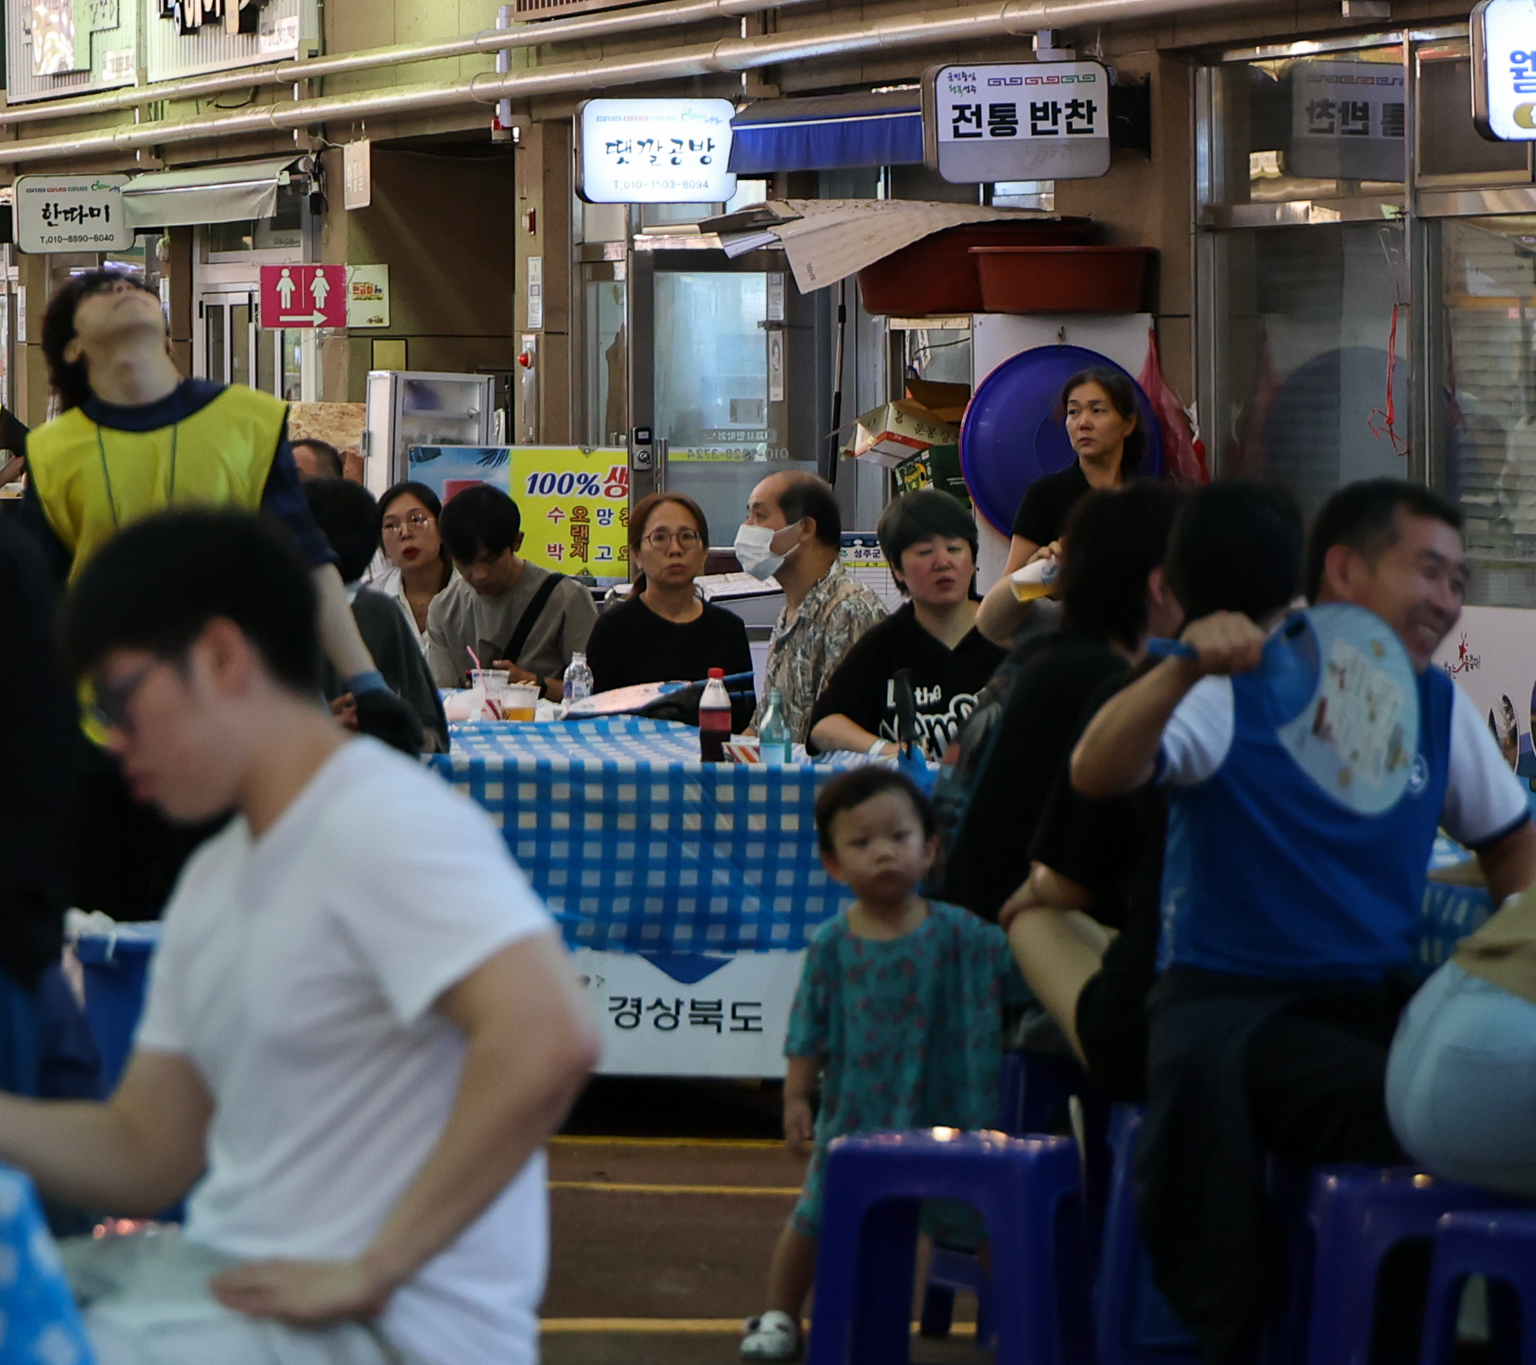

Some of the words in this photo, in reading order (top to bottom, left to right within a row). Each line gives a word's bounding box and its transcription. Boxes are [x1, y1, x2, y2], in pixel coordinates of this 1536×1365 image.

[951, 103, 1019, 139] 전통
[1029, 99, 1097, 136] 반찬
[41, 202, 110, 227] 한따미
[607, 996, 764, 1035] 경상북도
